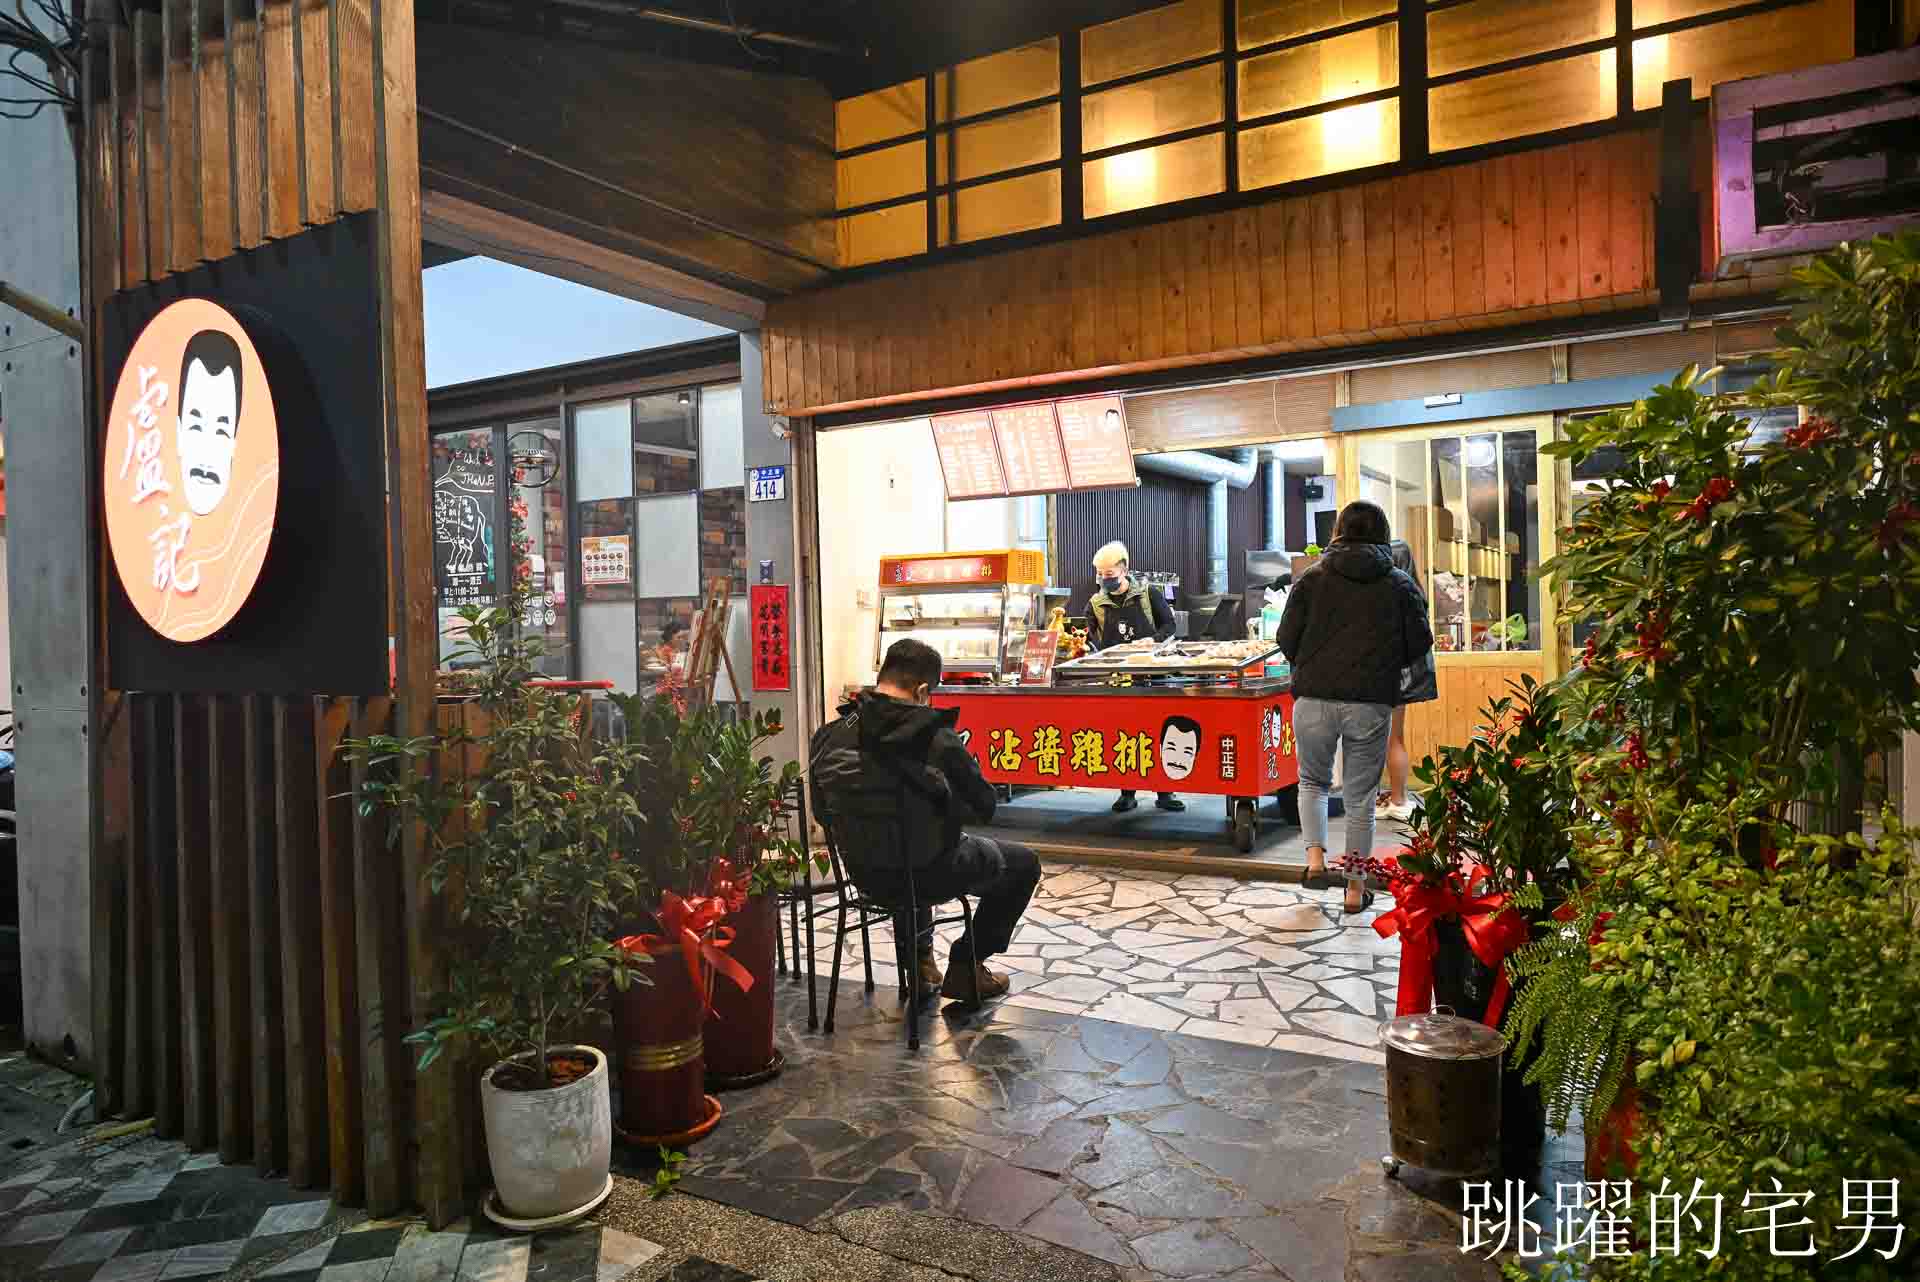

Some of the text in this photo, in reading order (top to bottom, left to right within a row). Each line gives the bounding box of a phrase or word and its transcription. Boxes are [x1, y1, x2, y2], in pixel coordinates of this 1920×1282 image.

[755, 480, 776, 499] 414
[990, 725, 1154, 777] 沾醬雞排
[1281, 720, 1297, 756] 沾
[1221, 737, 1235, 778] 中正店
